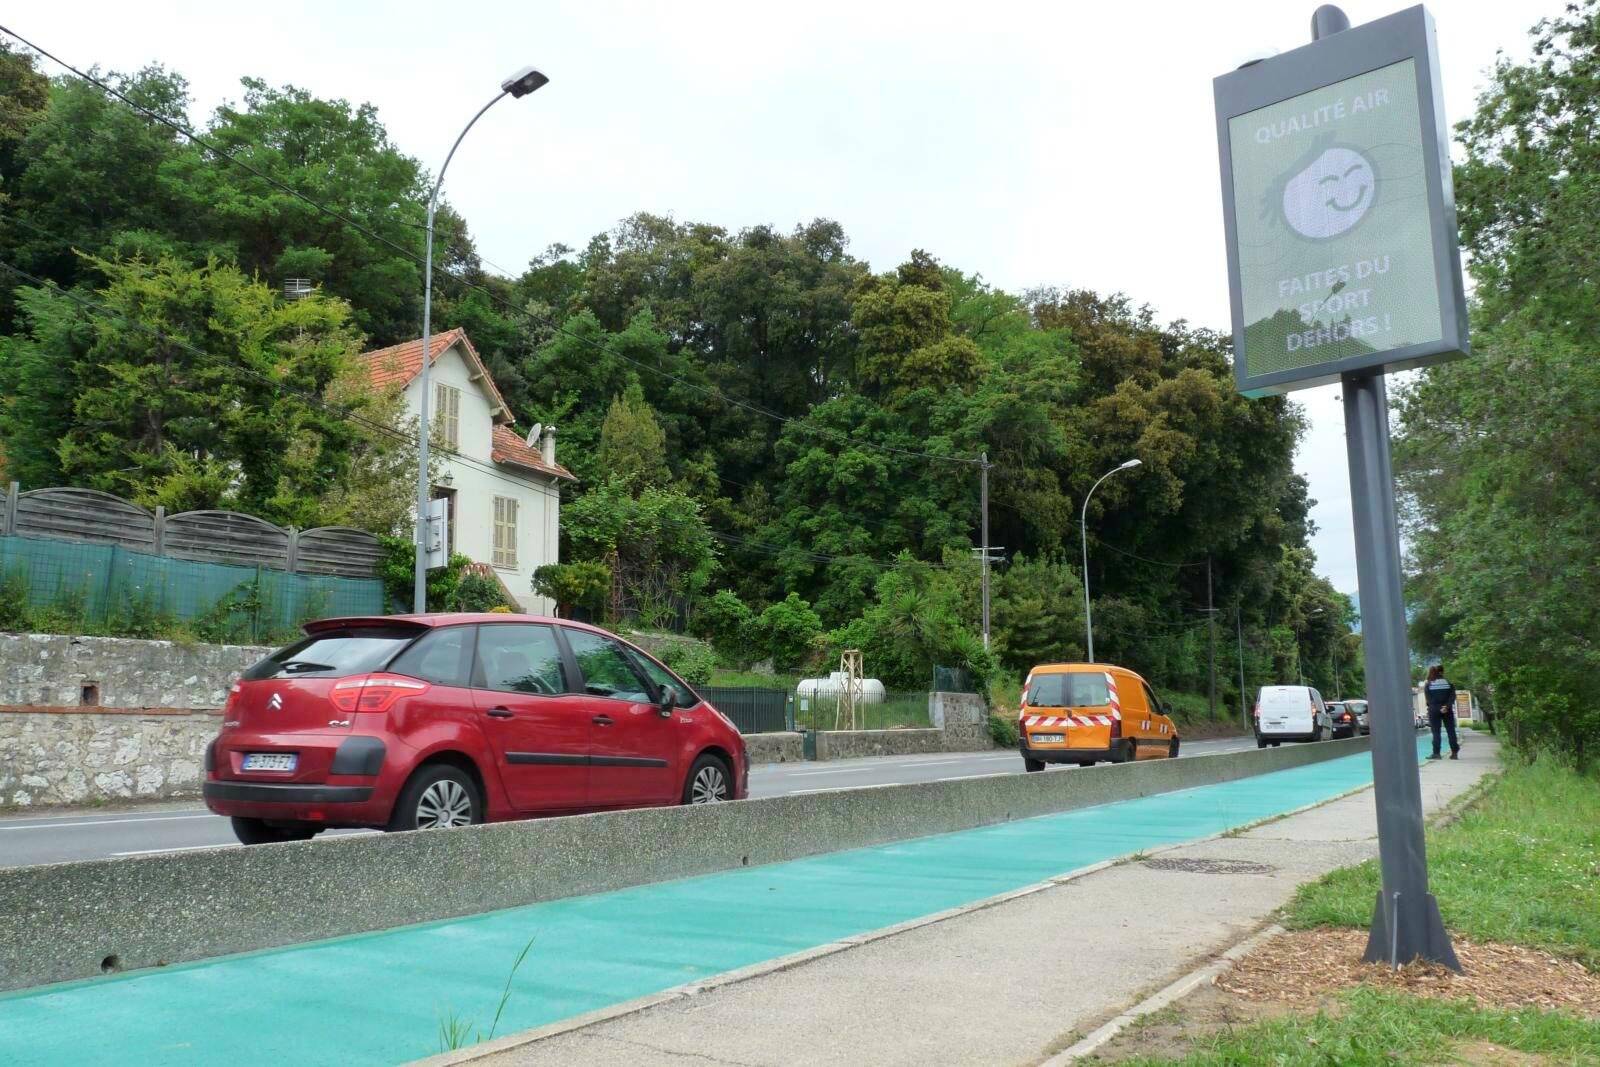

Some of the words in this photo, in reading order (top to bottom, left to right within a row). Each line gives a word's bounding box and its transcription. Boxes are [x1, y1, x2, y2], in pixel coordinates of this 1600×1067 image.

[1255, 99, 1345, 143] QUALITÉ
[1352, 88, 1390, 113] AIR
[1279, 265, 1350, 297] FAITES
[1357, 256, 1390, 280] DU
[1301, 288, 1373, 325] SPORT
